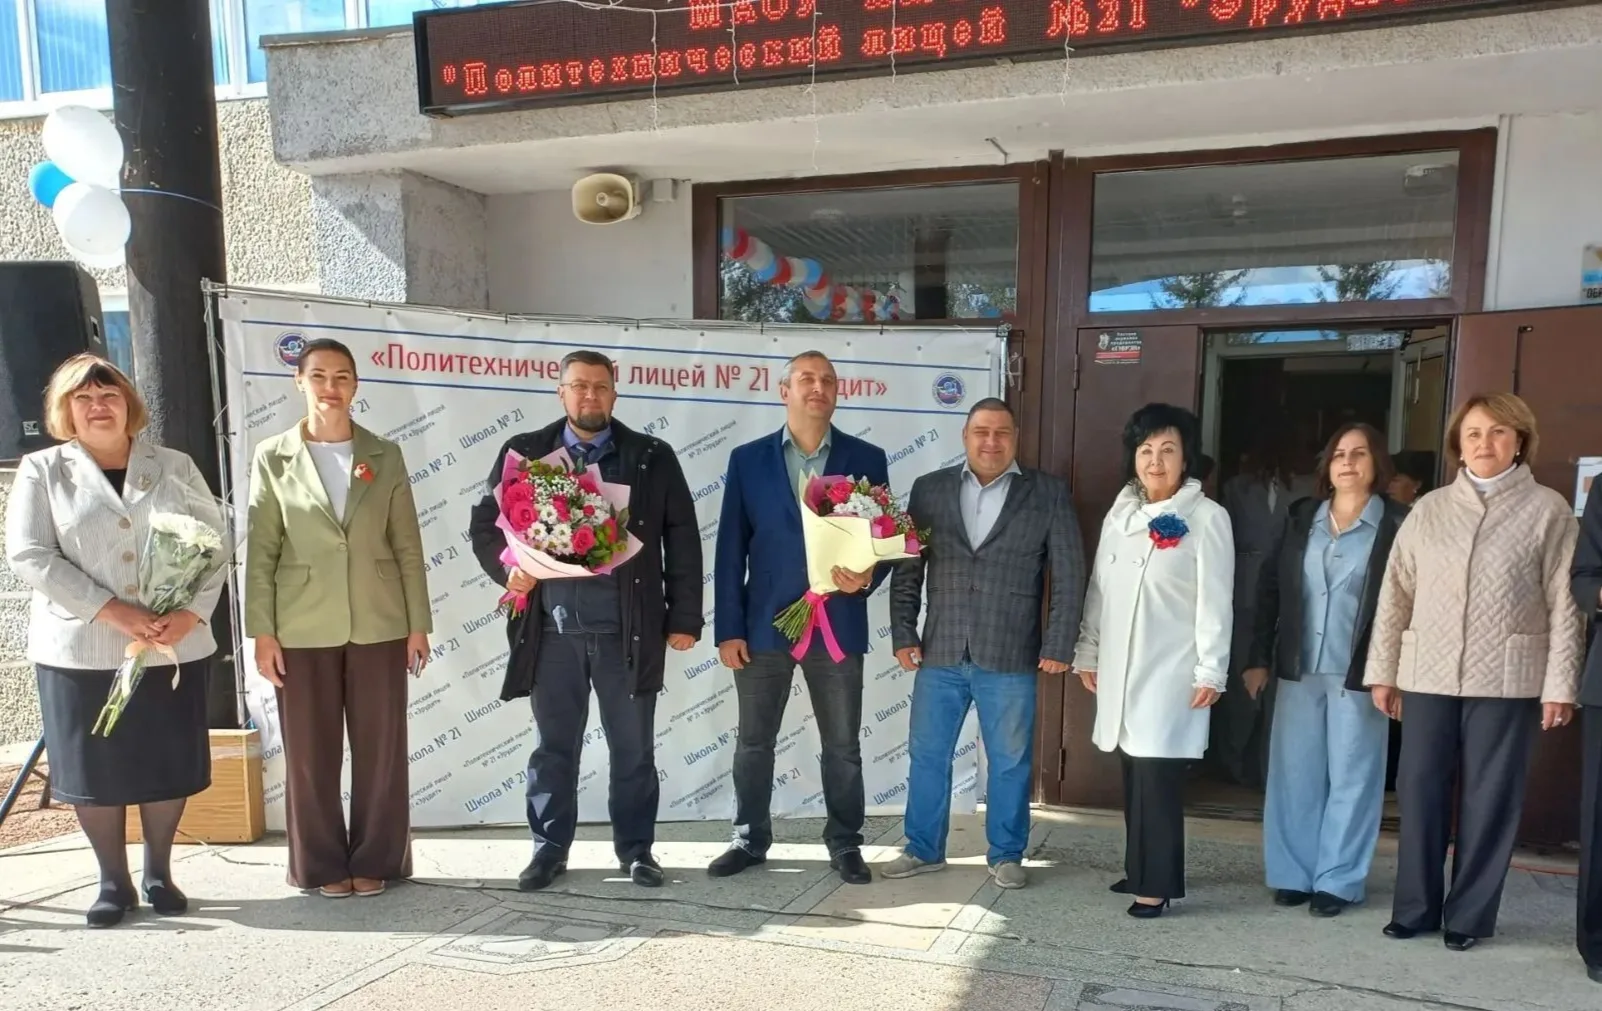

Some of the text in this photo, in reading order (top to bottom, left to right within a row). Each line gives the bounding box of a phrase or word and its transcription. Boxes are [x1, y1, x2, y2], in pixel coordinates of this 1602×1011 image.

[443, 26, 841, 95] "Политехнический
[861, 6, 1005, 57] лицей
[1097, 0, 1146, 31] 21
[628, 364, 705, 391] лицей
[716, 364, 741, 389] №
[749, 367, 769, 392] 21
[459, 408, 525, 449] Школа № 21
[657, 416, 670, 430] 21
[914, 435, 927, 449] №
[927, 428, 939, 442] 21
[428, 458, 442, 473] №
[442, 451, 457, 467] 21
[431, 552, 445, 567] №
[444, 545, 459, 560] 21
[462, 608, 505, 634] Школа
[433, 637, 460, 658] № 21
[684, 657, 720, 681] Школа
[791, 684, 802, 697] 21
[464, 698, 502, 724] Школа
[874, 699, 909, 723] Школа
[858, 725, 873, 739] 21
[408, 726, 462, 765] кола № 21
[684, 742, 719, 767] Школа
[717, 731, 730, 747] №
[658, 769, 669, 783] 21
[776, 772, 789, 788] №
[790, 767, 802, 780] 21
[465, 769, 529, 814] Школа № 21
[873, 781, 908, 806] Школа
